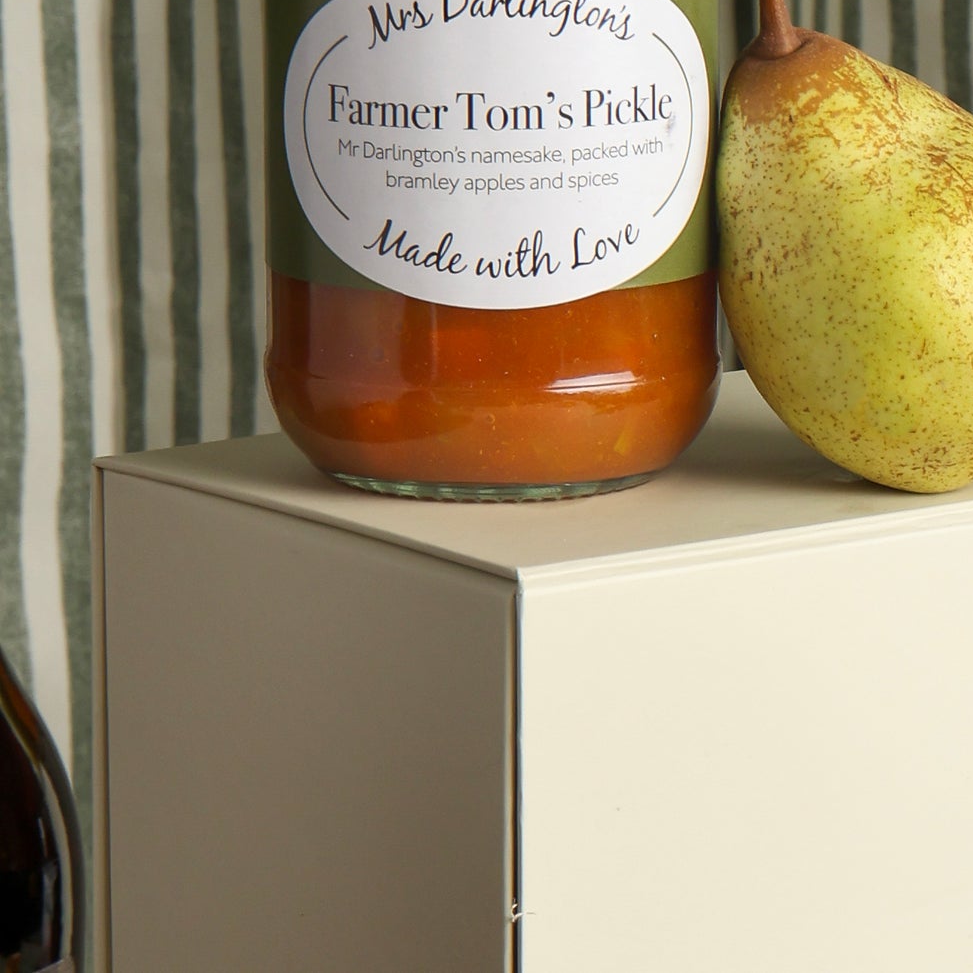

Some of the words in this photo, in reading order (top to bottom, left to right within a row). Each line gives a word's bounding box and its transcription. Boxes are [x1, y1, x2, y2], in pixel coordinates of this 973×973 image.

[368, 1, 433, 50] Mrs
[328, 84, 448, 131] Farmer
[456, 90, 574, 132] Tom's
[583, 83, 673, 127] Pickle
[338, 139, 359, 158] Mr
[363, 140, 466, 168] Darlington's
[471, 143, 566, 165] namesake,
[571, 141, 628, 166] packed
[632, 138, 664, 156] with
[385, 171, 460, 195] bramley
[464, 172, 526, 195] apples
[529, 172, 563, 190] and
[568, 172, 619, 193] spices
[363, 219, 467, 275] Made
[475, 230, 561, 279] with
[571, 222, 640, 269] Love
